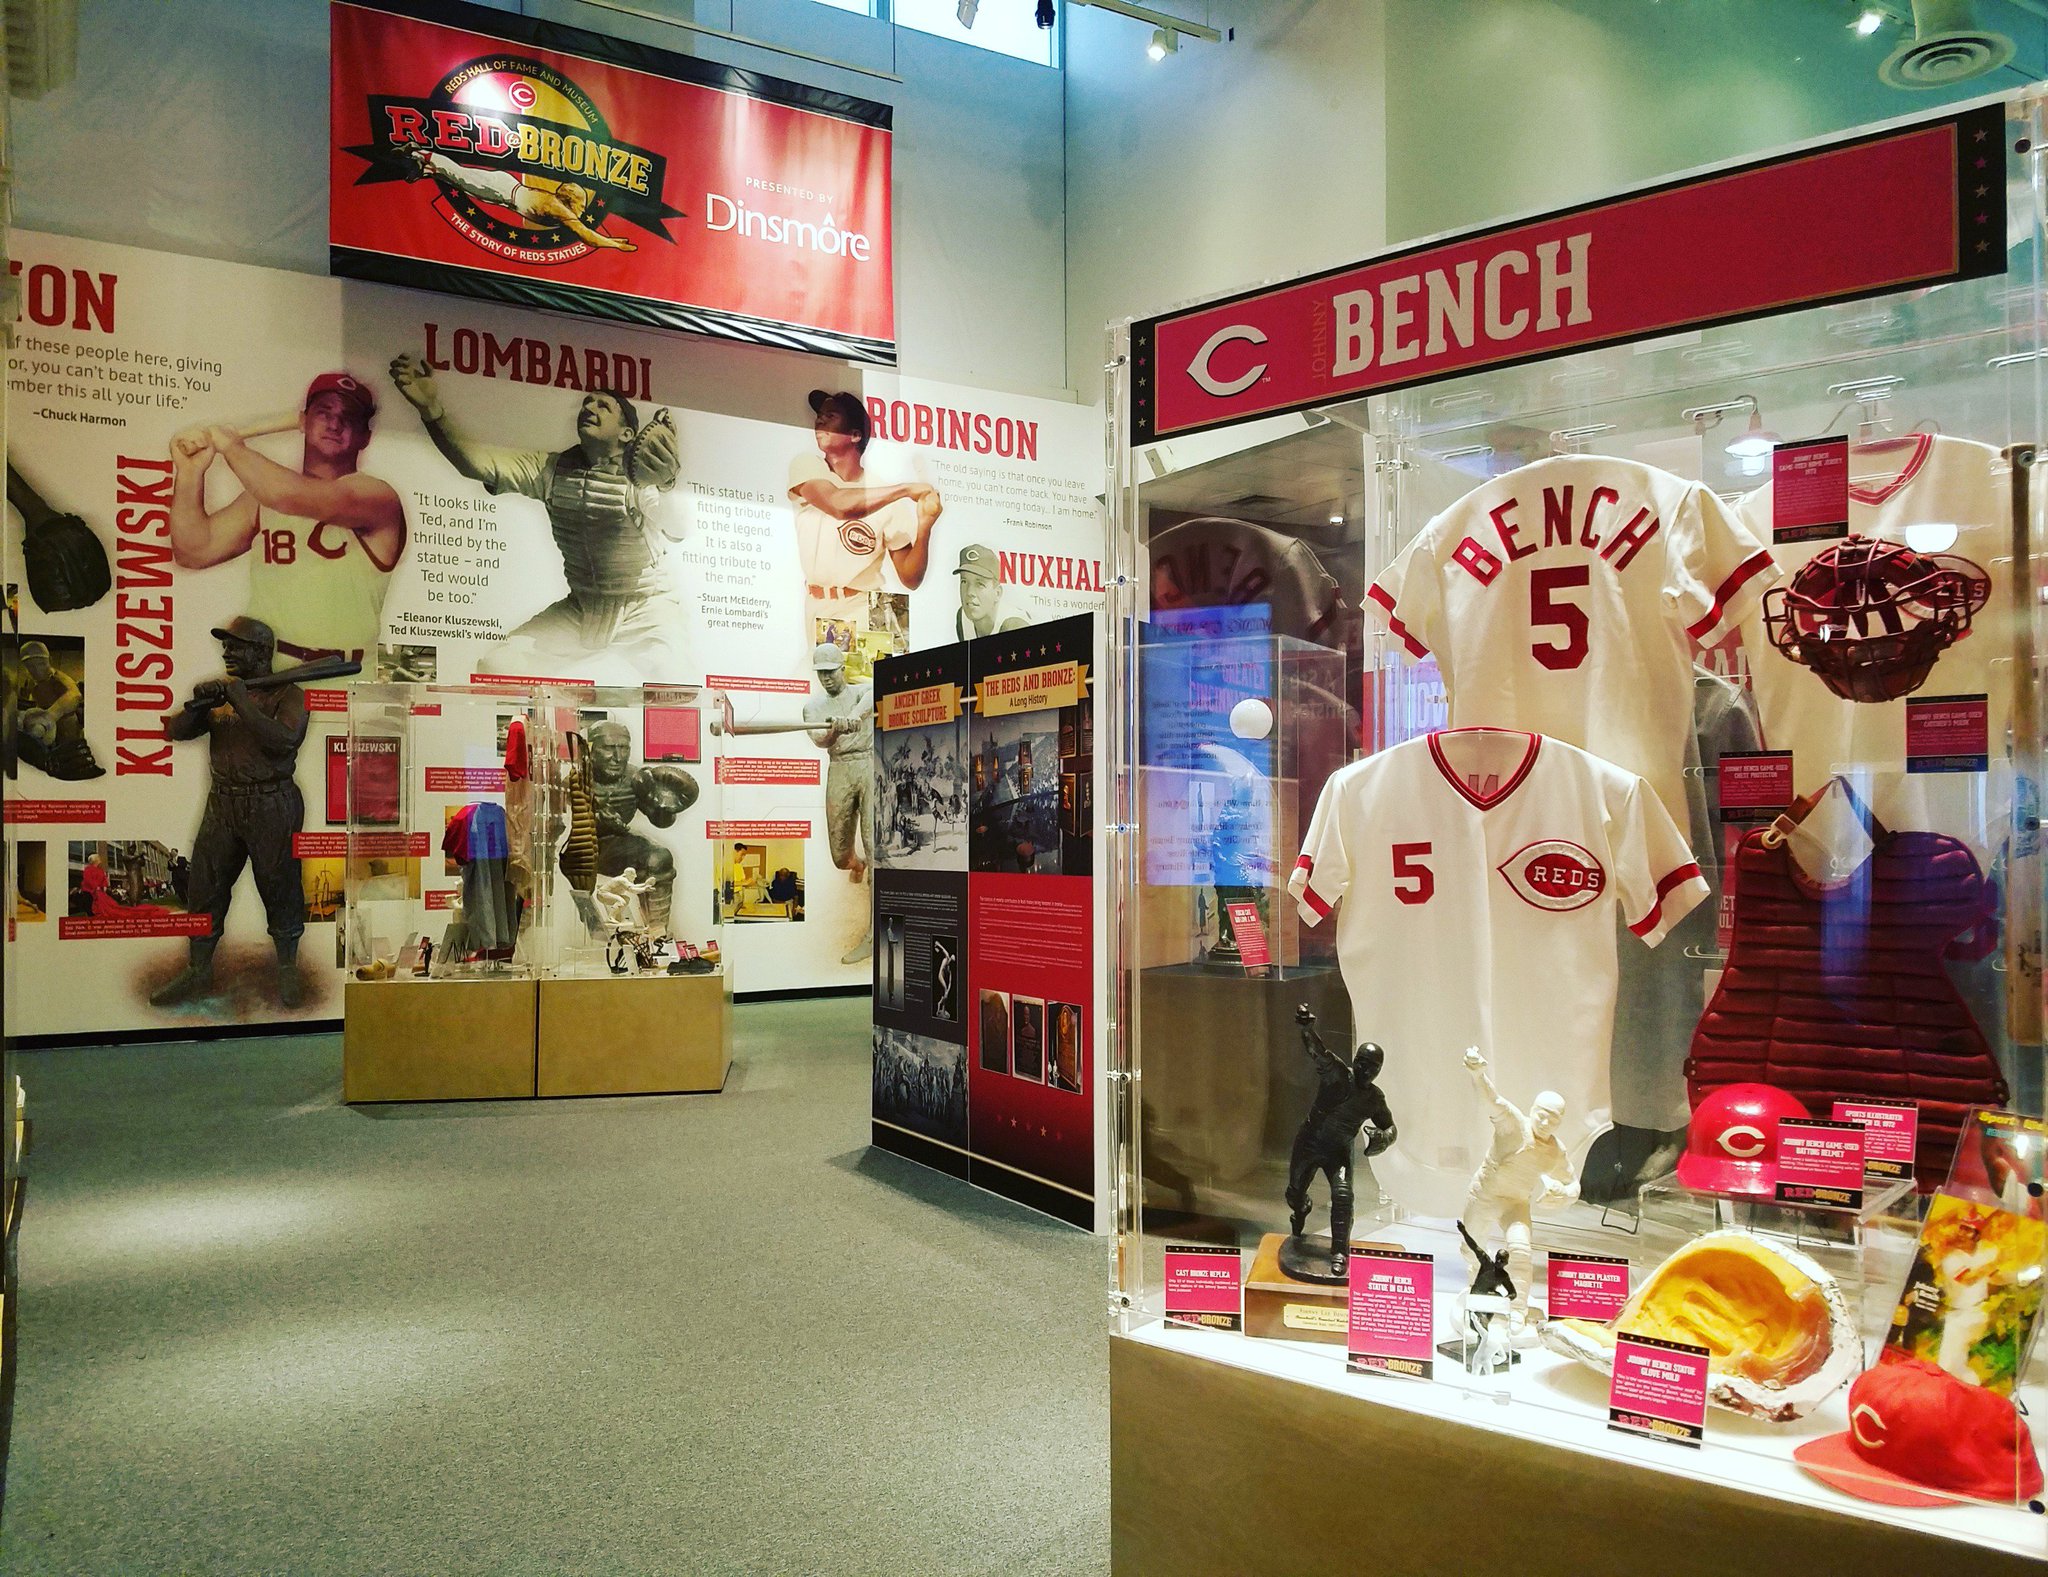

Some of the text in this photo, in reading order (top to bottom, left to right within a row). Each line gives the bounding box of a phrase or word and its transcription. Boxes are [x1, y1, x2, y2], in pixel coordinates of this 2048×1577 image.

[445, 60, 598, 124] REDS HALL OF FAME AND MUSEUM
[385, 106, 651, 195] RED to BRONZE
[745, 176, 833, 204] PRESENTED BY
[451, 213, 587, 262] THE STORY OF REDS STATUES
[1333, 232, 1593, 379] BENCH
[26, 337, 70, 355] these
[76, 345, 129, 363] people
[135, 350, 172, 369] here,
[176, 357, 222, 376] giving
[424, 323, 652, 401] LOMBARDI
[32, 361, 60, 375] you
[66, 365, 104, 380] can't
[109, 368, 143, 384] beat
[148, 373, 180, 389] this.
[184, 377, 211, 392] You
[57, 383, 87, 399] this
[92, 387, 112, 401] all
[116, 392, 151, 406] your
[80, 412, 126, 427] Harmon
[866, 396, 1038, 461] ROBINSON
[953, 464, 967, 474] old
[969, 466, 996, 480] saying
[999, 470, 1006, 480] is
[1007, 472, 1025, 482] that
[1026, 475, 1045, 485] once
[1047, 477, 1063, 488] you
[1065, 479, 1085, 490] leave
[718, 486, 753, 501] statue
[756, 490, 765, 501] is
[768, 495, 774, 503] a
[966, 480, 982, 491] you
[1006, 487, 1028, 497] come
[1052, 492, 1067, 502] You
[1069, 493, 1087, 504] have
[434, 495, 469, 510] looks
[473, 500, 497, 513] like
[697, 501, 771, 521] fitting tribute
[944, 492, 973, 502] proven
[975, 496, 993, 507] that
[995, 499, 1021, 512] wrong
[1058, 507, 1070, 516] am
[420, 512, 497, 531] Ted, and I'm
[697, 519, 773, 537] to the legend.
[1025, 520, 1053, 531] Robinson
[414, 532, 507, 551] thrilled by the
[706, 536, 762, 552] It is also a
[1452, 484, 1660, 587] BENCH
[262, 529, 296, 565] 18
[417, 552, 459, 565] statue
[476, 558, 500, 569] and
[682, 551, 771, 571] fitting tribute to
[421, 569, 489, 587] Ted would
[705, 571, 724, 584] the
[427, 589, 444, 602] be
[1054, 598, 1061, 607] is
[1063, 600, 1068, 608] a
[116, 455, 174, 777] KLUSZEWSKI
[445, 615, 502, 629] Kluszewski,
[701, 605, 768, 619] Ernie Lombardi's
[1531, 565, 1589, 670] 5
[389, 624, 407, 635] Ted
[409, 626, 472, 639] Kluszewski's
[707, 619, 764, 630] great nephew
[986, 667, 1076, 697] THE REDS AND BRONZE:
[894, 688, 941, 710] ANCIENT GREEK
[1010, 694, 1048, 709] A Long History
[888, 705, 947, 728] BRONZE SCULPTURE
[1392, 842, 1434, 905] 5
[1533, 866, 1599, 888] REDS
[1201, 1314, 1232, 1327] BRONZE
[1388, 1358, 1423, 1374] BRONZE
